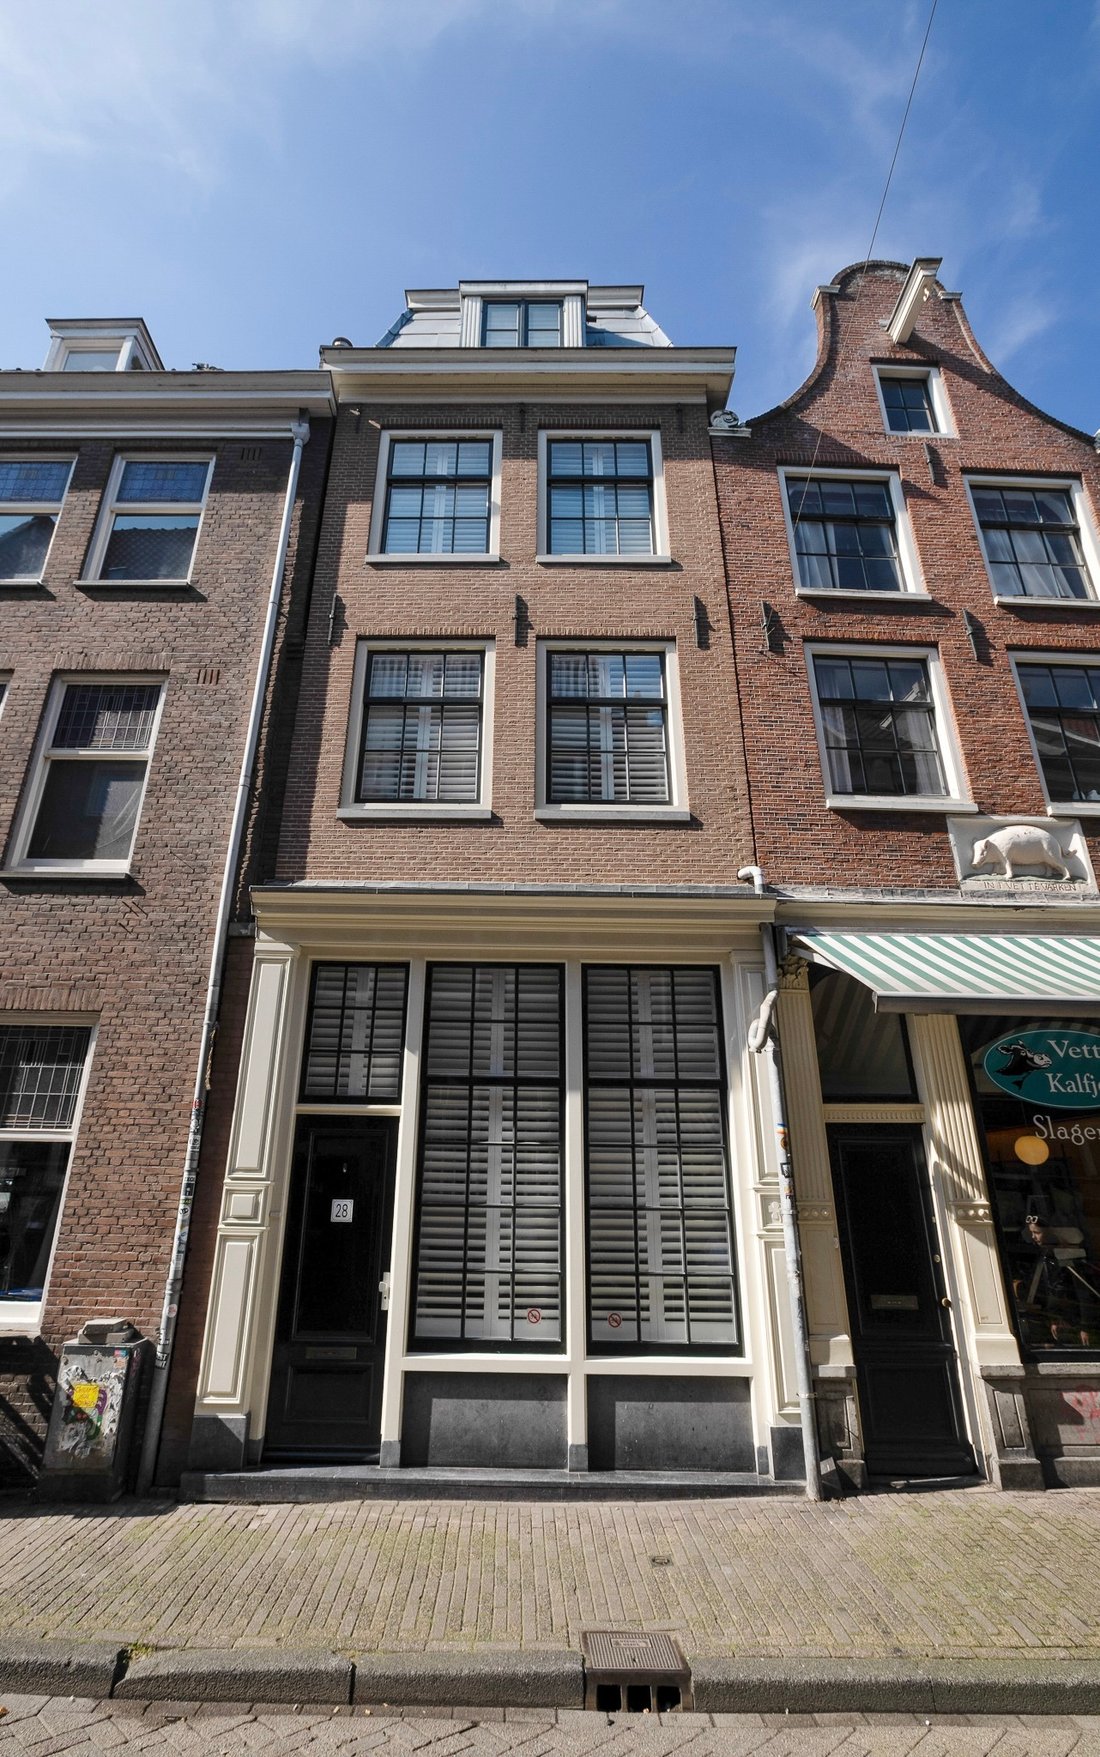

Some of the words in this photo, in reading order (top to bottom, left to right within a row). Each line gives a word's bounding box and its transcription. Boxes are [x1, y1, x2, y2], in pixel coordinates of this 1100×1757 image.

[1047, 1040, 1100, 1058] Vett
[1045, 1073, 1100, 1098] Kalfj
[335, 1203, 348, 1218] 28
